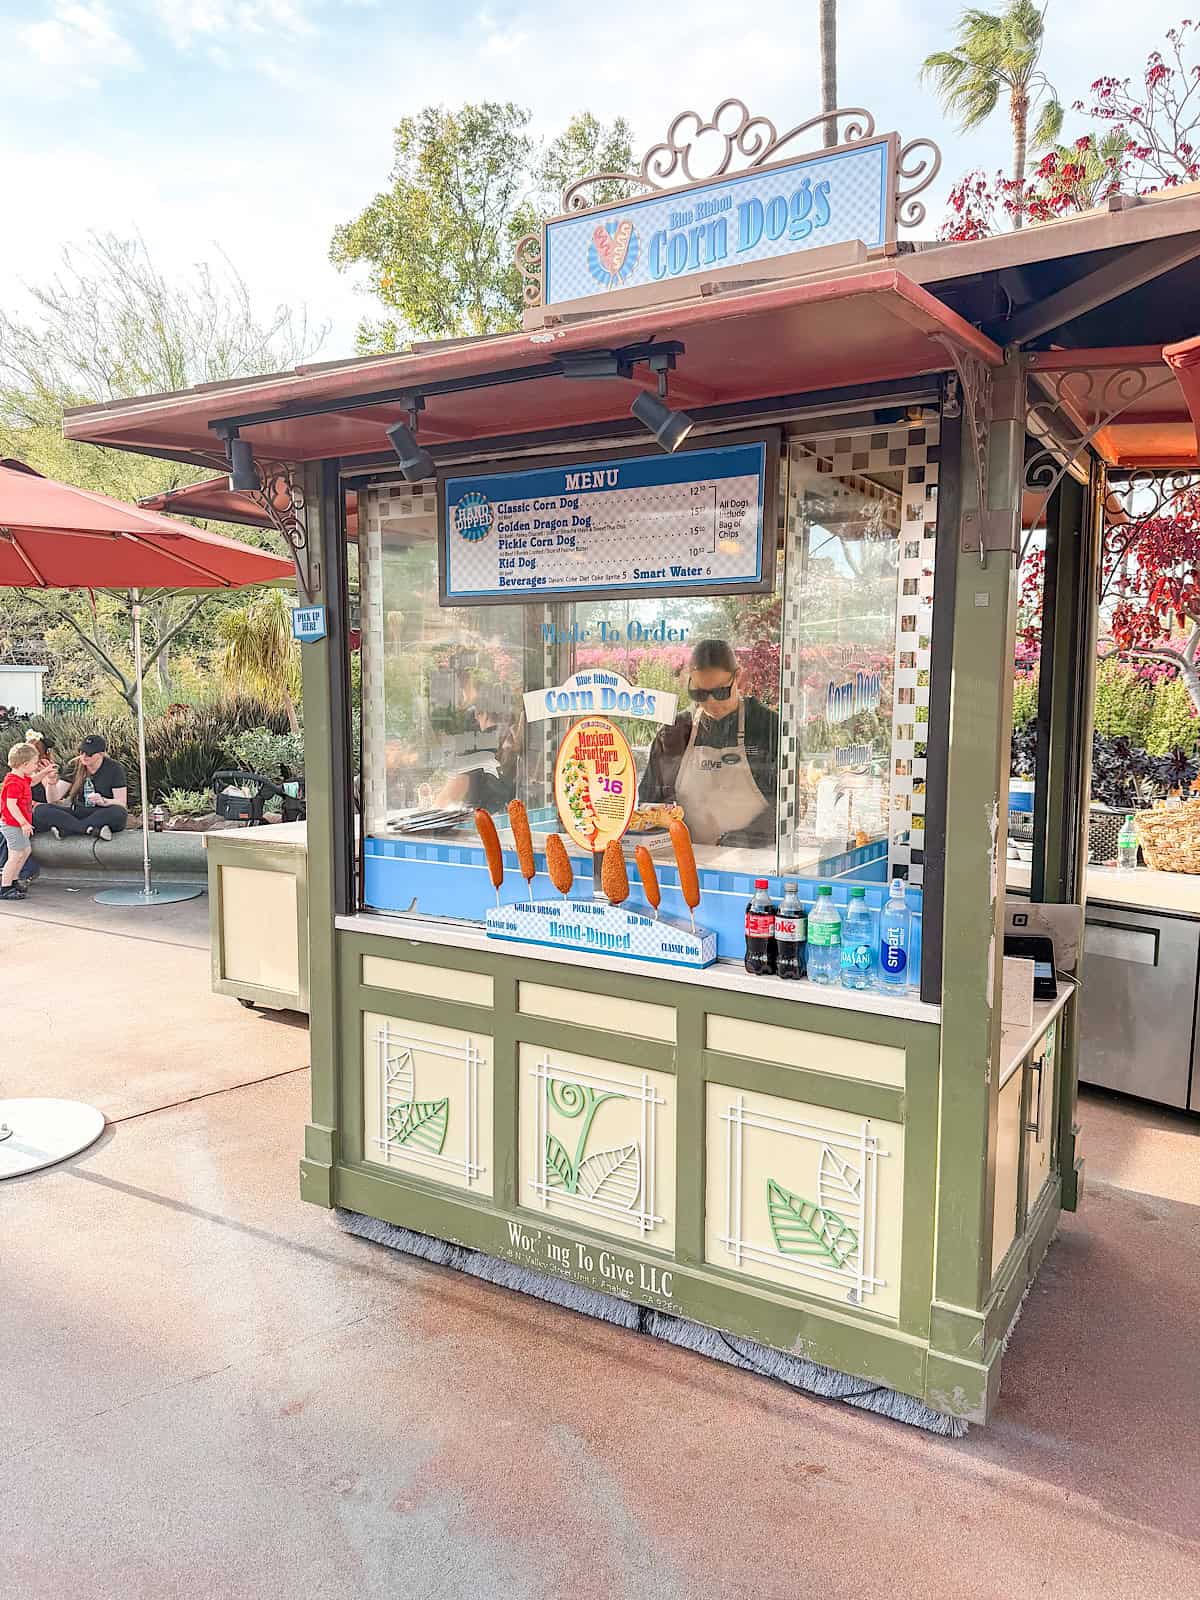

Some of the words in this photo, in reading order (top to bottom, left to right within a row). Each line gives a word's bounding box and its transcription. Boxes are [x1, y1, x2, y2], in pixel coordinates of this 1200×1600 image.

[671, 209, 693, 230] Blue
[695, 194, 733, 222] Ribbon
[648, 216, 728, 280] Corn
[736, 174, 831, 253] Dogs
[565, 469, 619, 491] MENU
[458, 504, 489, 520] HAND
[497, 503, 530, 514] Classic
[533, 500, 556, 511] Corn
[560, 498, 579, 510] Dog
[719, 500, 729, 509] All
[730, 499, 749, 509] Dogs
[455, 513, 492, 530] DIPPED
[497, 520, 530, 533] Golden
[533, 517, 568, 532] Dragon
[572, 515, 592, 529] Dog
[719, 521, 733, 530] Bag
[733, 520, 741, 528] of
[498, 538, 527, 550] Pickle
[530, 537, 554, 547] Corn
[557, 535, 576, 547] Dog
[718, 530, 739, 540] Chips
[498, 558, 515, 569] Kid
[518, 557, 536, 570] Dog
[499, 576, 547, 588] Beverages
[621, 571, 627, 580] 5
[633, 568, 666, 580] Smart
[669, 566, 703, 577] Water
[706, 567, 712, 576] 6
[539, 622, 591, 642] Made
[597, 620, 620, 642] To
[626, 620, 689, 642] Order
[575, 675, 592, 687] Blue
[593, 674, 619, 687] Ribbon
[544, 688, 595, 713] Corn
[600, 687, 656, 716] Dogs
[826, 680, 853, 722] Corn
[856, 671, 881, 714] Dogs
[577, 730, 615, 747] Mexican
[575, 746, 599, 760] Street
[600, 748, 618, 762] Corn
[595, 760, 610, 776] Dog
[598, 776, 624, 794] $16
[514, 903, 536, 915] GOLDEN
[537, 905, 561, 917] DRAGON
[572, 903, 590, 914] PICKLE
[592, 905, 605, 916] DOG
[505, 921, 518, 932] DOG
[627, 915, 638, 926] KID
[639, 916, 653, 927] DOG
[775, 920, 795, 933] oke
[549, 921, 631, 949] Hand-Dipped
[661, 942, 684, 955] CLASSIC
[685, 944, 699, 957] DOG
[888, 927, 900, 967] smart
[841, 951, 870, 964] DASANI
[575, 1242, 593, 1272] To
[600, 1252, 634, 1285] Give
[639, 1263, 673, 1298] LLC
